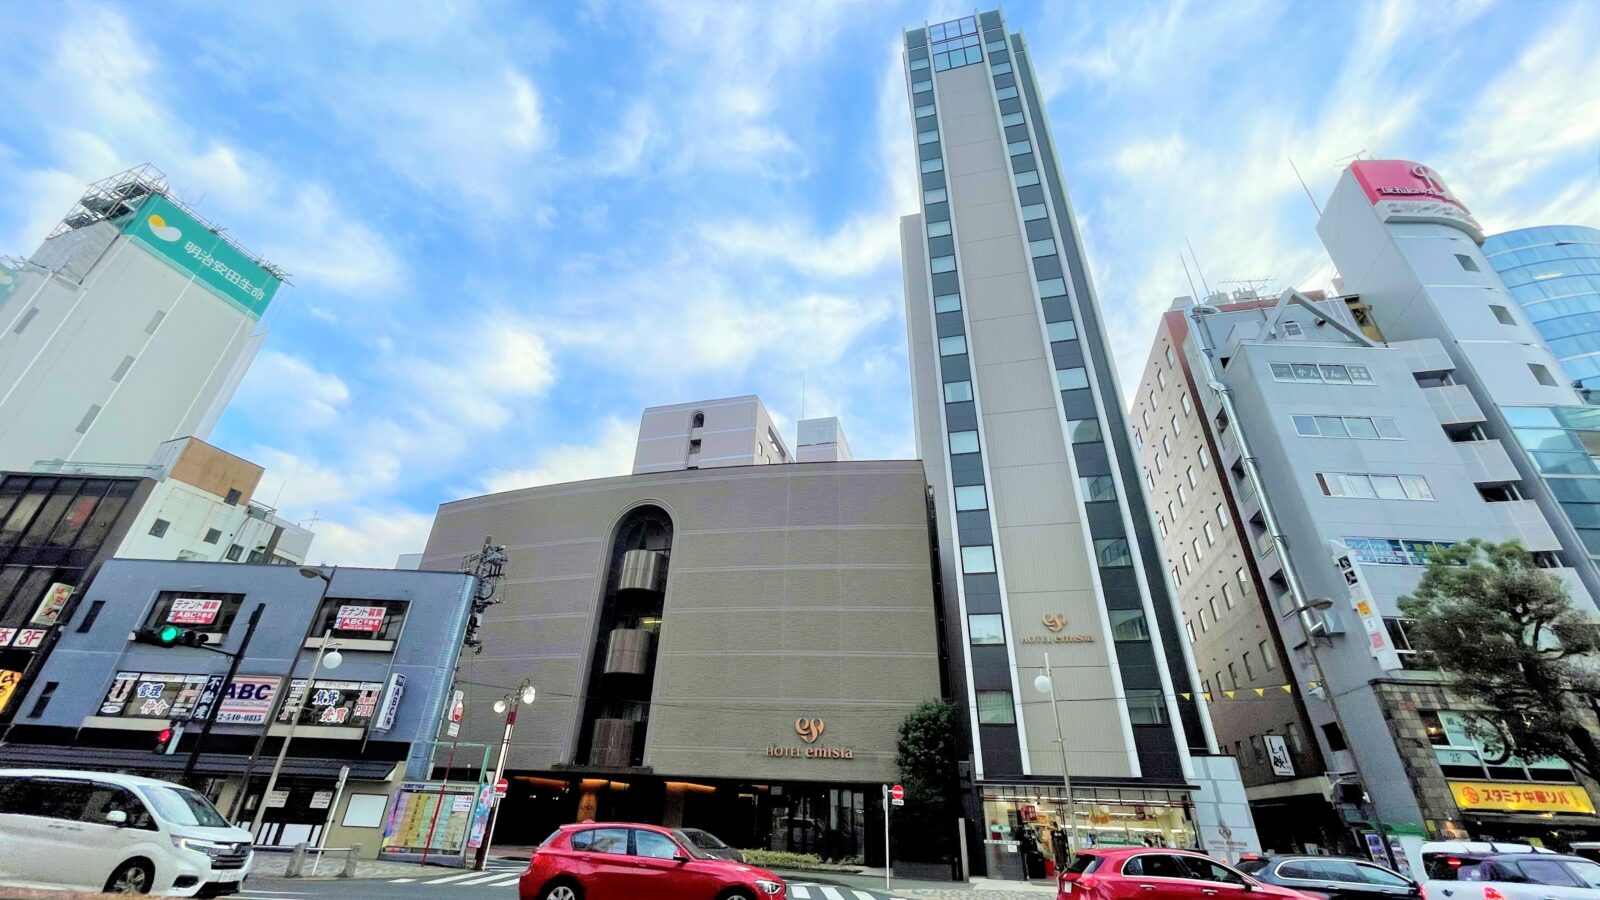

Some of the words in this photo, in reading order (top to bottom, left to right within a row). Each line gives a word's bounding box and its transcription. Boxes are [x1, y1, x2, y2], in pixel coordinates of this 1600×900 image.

[184, 241, 265, 301] 明治安田生命
[18, 630, 44, 645] 3F
[193, 677, 221, 719] 不動産
[225, 683, 271, 700] ABC
[766, 746, 800, 757] HOTEL
[805, 748, 854, 759] emisia
